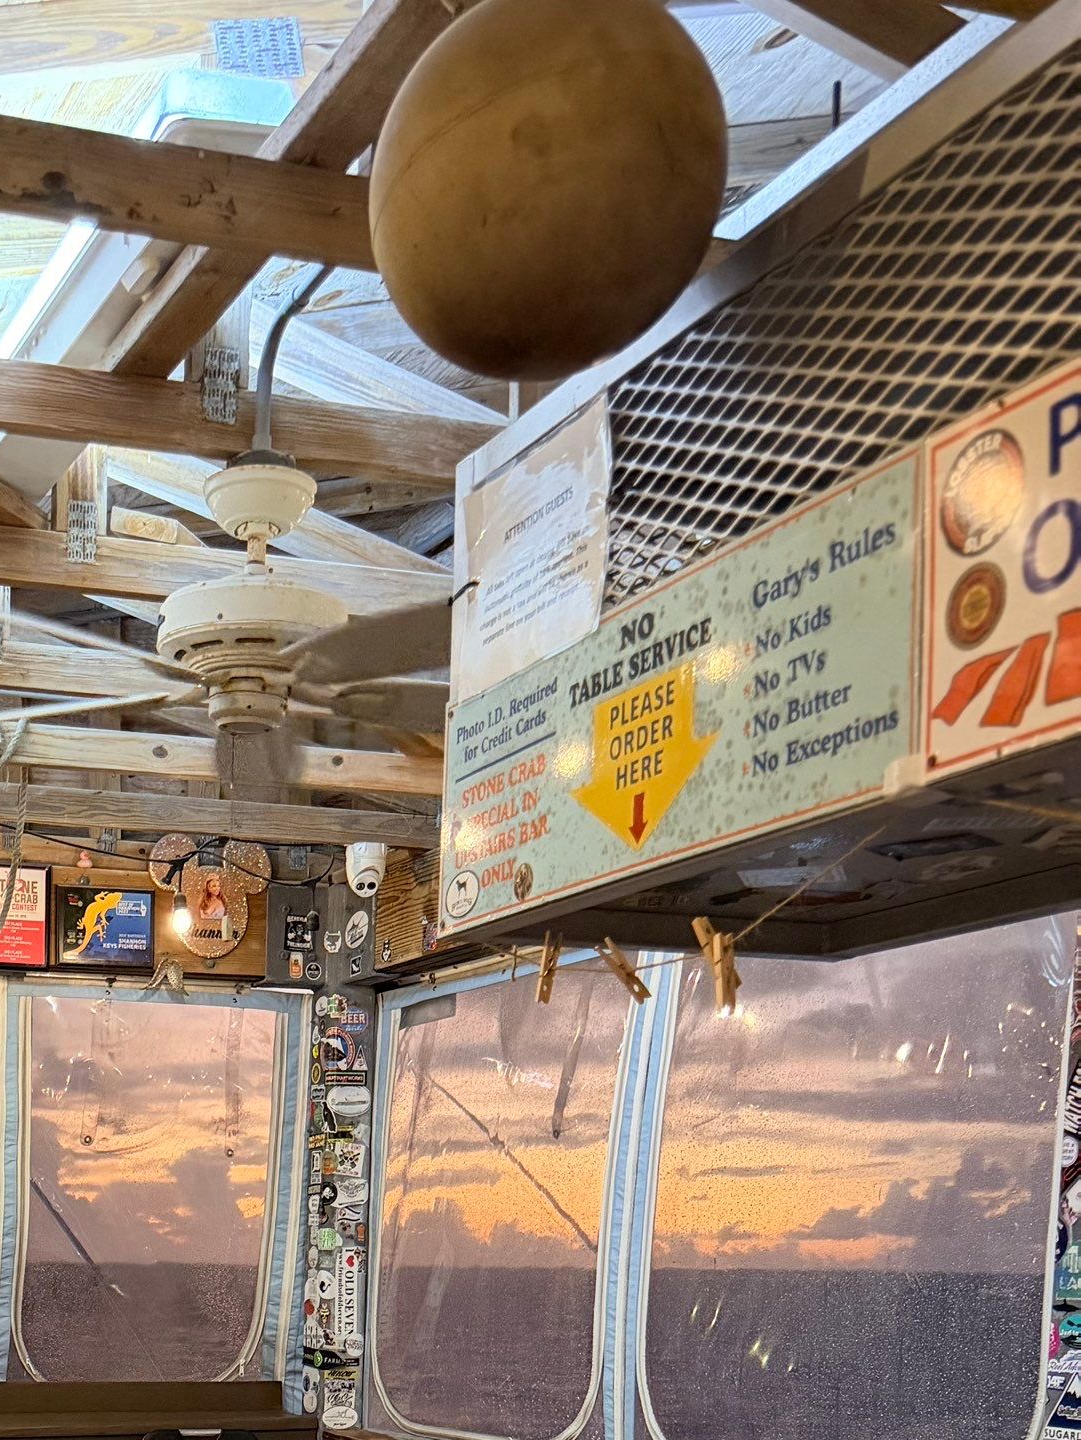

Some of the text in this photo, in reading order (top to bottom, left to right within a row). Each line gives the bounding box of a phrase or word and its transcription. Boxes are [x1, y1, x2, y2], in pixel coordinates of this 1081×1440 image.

[504, 503, 544, 544] ATTENTION
[545, 485, 573, 515] GUESTS
[753, 522, 896, 608] Gary's Rules
[620, 613, 655, 652] NO
[755, 605, 832, 658] No Kids
[569, 618, 712, 708] TABLE SERVICE
[753, 650, 826, 699] No TVs
[456, 677, 558, 745] Photo I.D. Required
[610, 680, 675, 730] PLEASE
[753, 684, 852, 738] No Butter
[463, 710, 547, 763] for Credit Cards
[610, 715, 673, 761] ORDER
[752, 708, 900, 777] No Exceptions
[462, 753, 546, 809] STONE CRAB
[616, 750, 663, 790] HERE
[522, 788, 540, 812] IN
[518, 814, 551, 847] BAR
[480, 857, 516, 888] ONLY
[15, 893, 38, 904] CRAB
[341, 1014, 365, 1023] BEER
[345, 1271, 354, 1295] OLD
